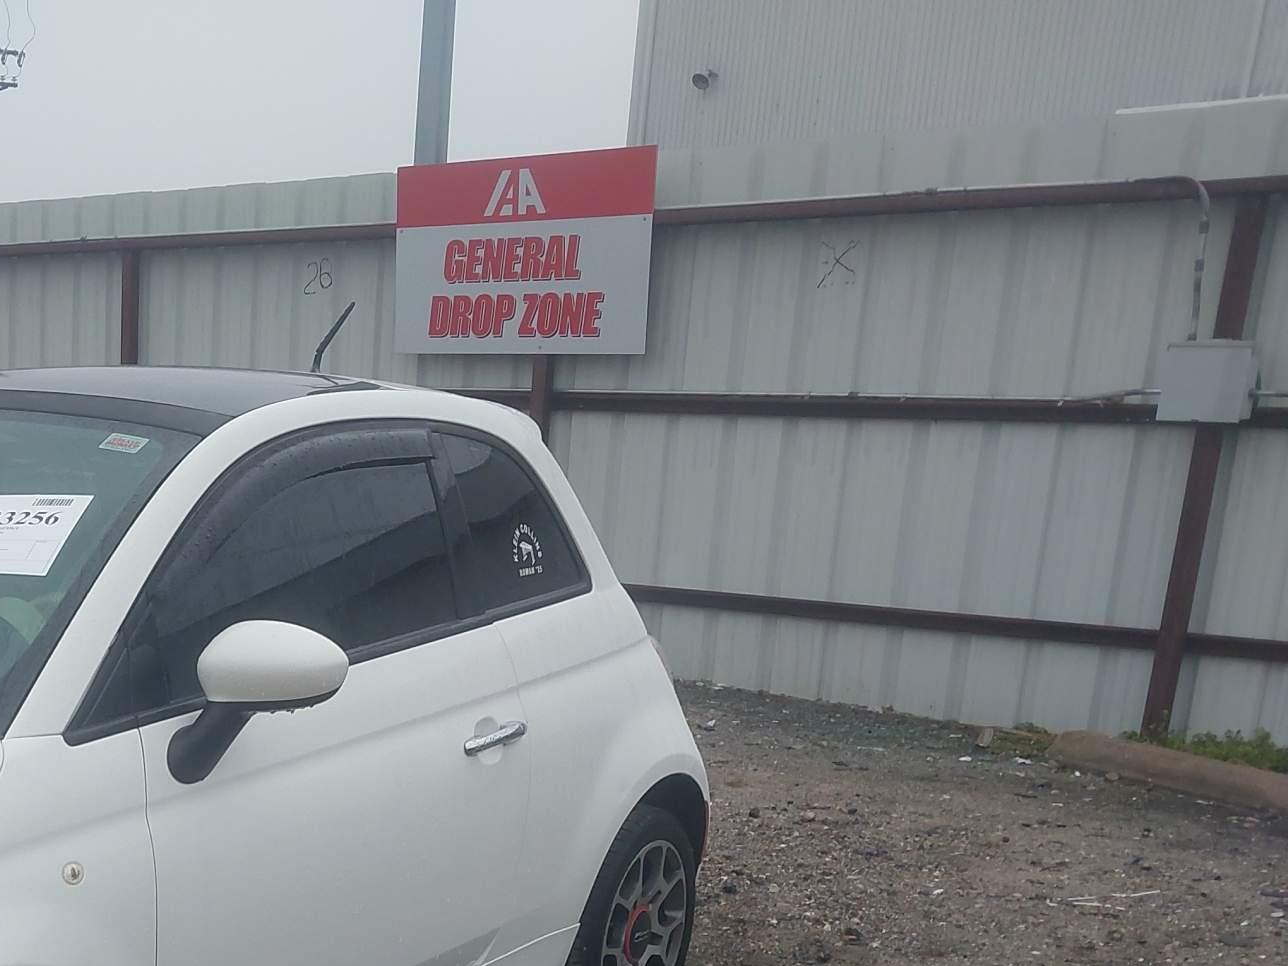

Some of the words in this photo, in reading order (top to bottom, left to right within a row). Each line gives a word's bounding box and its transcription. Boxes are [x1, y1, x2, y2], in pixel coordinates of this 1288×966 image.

[304, 257, 333, 295] 26
[443, 234, 581, 284] GENERAL
[428, 293, 516, 338] DROP
[518, 291, 605, 338] ZONE
